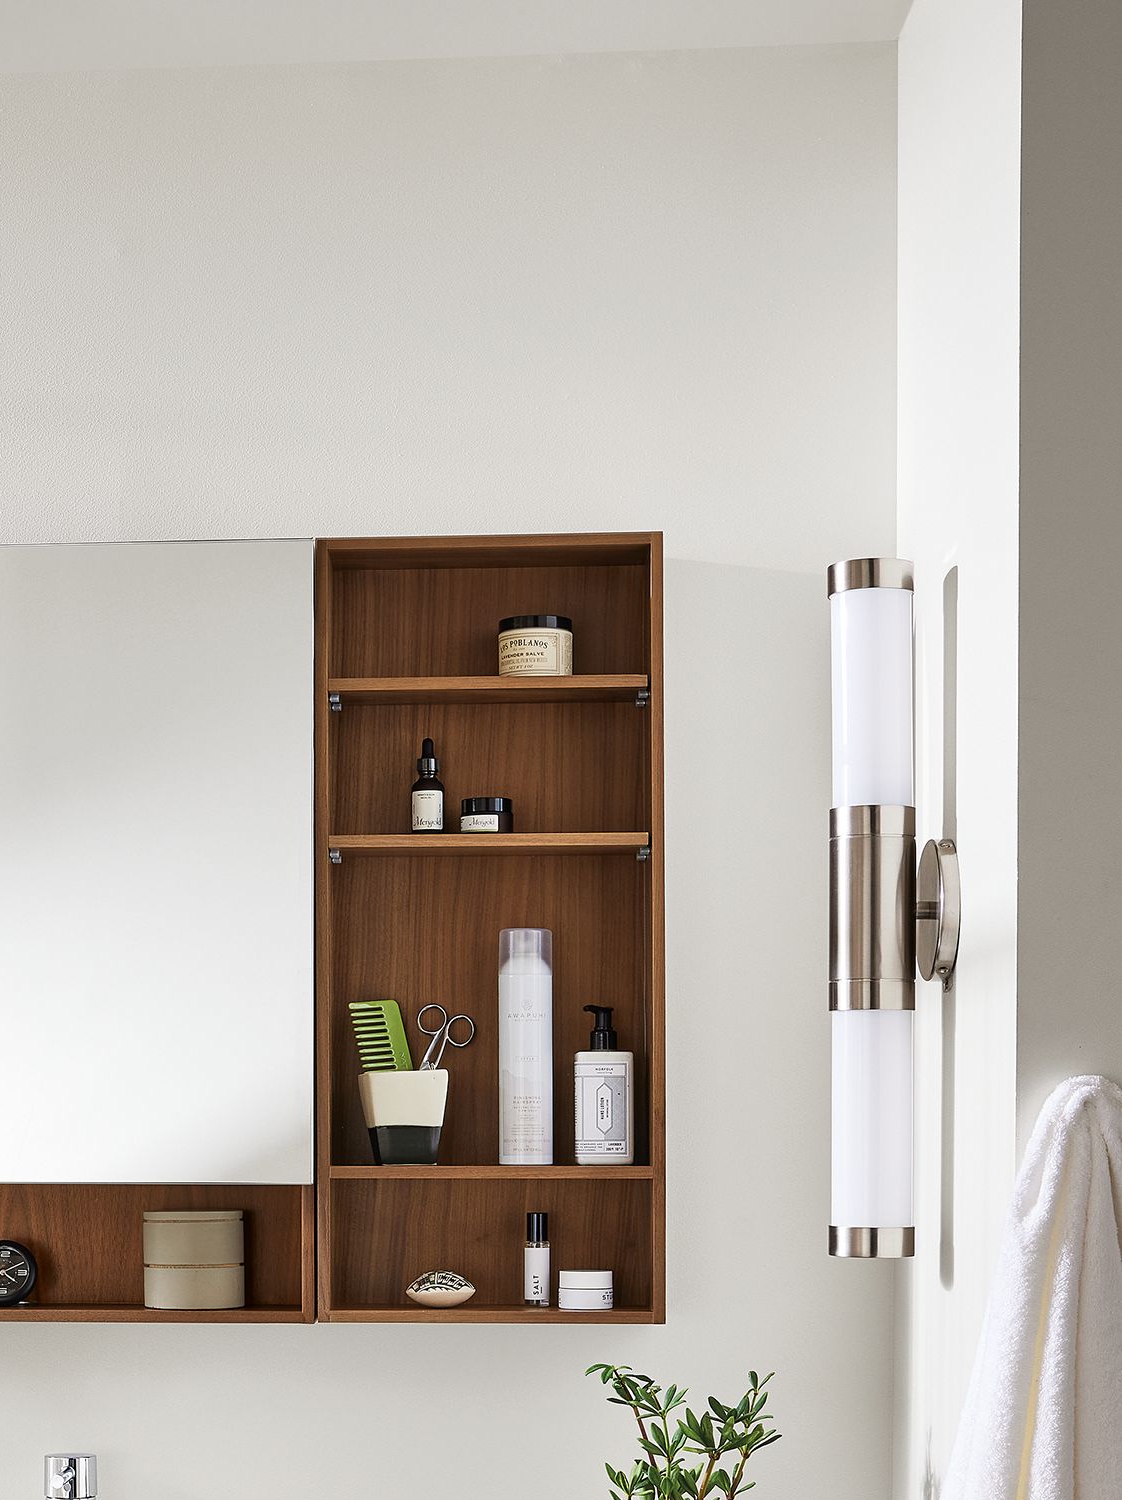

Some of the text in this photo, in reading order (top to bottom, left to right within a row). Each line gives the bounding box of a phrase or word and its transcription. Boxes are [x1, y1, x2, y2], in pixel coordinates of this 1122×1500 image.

[500, 639, 549, 653] LOS POBLANOS
[501, 652, 524, 660] LAVENDER
